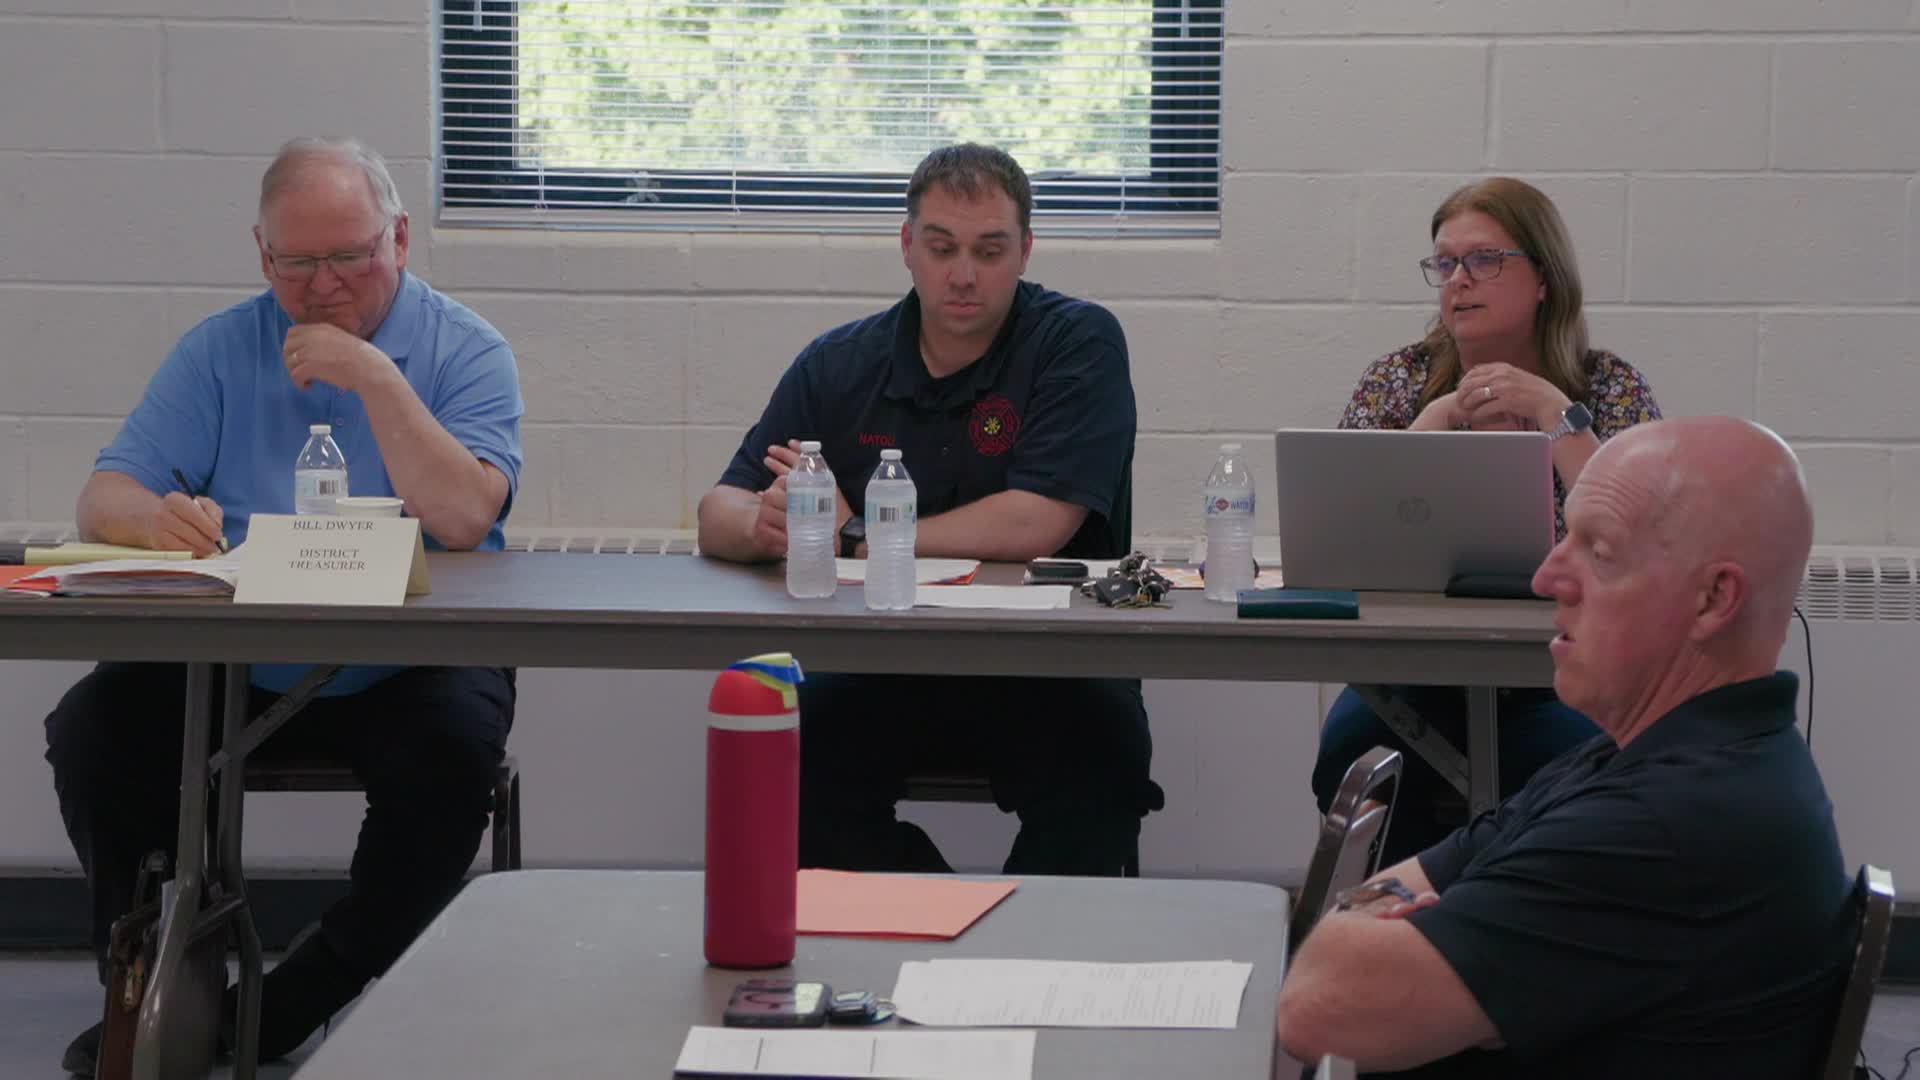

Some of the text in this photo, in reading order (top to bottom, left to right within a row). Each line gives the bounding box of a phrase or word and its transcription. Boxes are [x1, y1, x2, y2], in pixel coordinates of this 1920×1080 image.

[292, 519, 374, 531] BILL DWYER
[299, 548, 360, 559] DISTRICT
[289, 560, 366, 571] TREASURER
